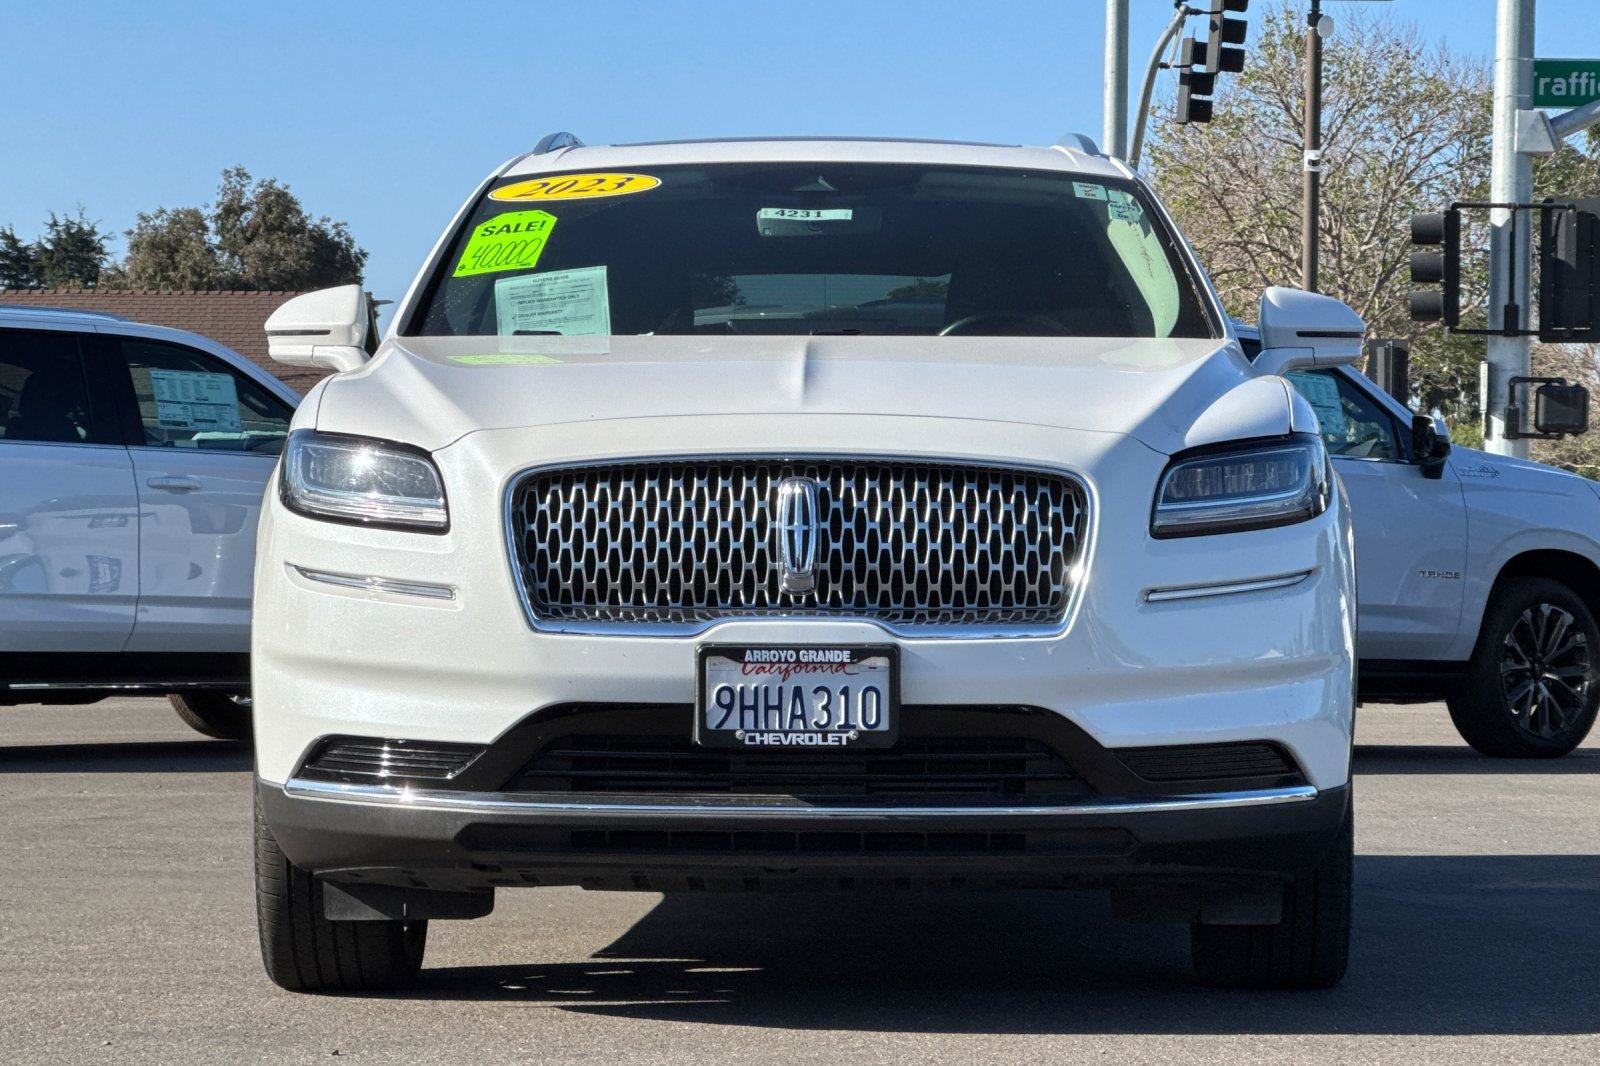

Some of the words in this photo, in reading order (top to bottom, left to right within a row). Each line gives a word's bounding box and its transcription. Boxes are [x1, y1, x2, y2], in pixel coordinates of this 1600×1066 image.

[1533, 71, 1600, 96] raffi
[515, 176, 634, 199] 2023
[774, 209, 823, 218] 4231
[481, 219, 547, 237] SALE!
[1418, 569, 1461, 580] TAHOE
[744, 649, 795, 663] ARROYO
[799, 649, 851, 663] GRANDE
[741, 661, 860, 683] California
[714, 685, 882, 730] 9HHA310
[744, 732, 849, 746] CHEVROLET
